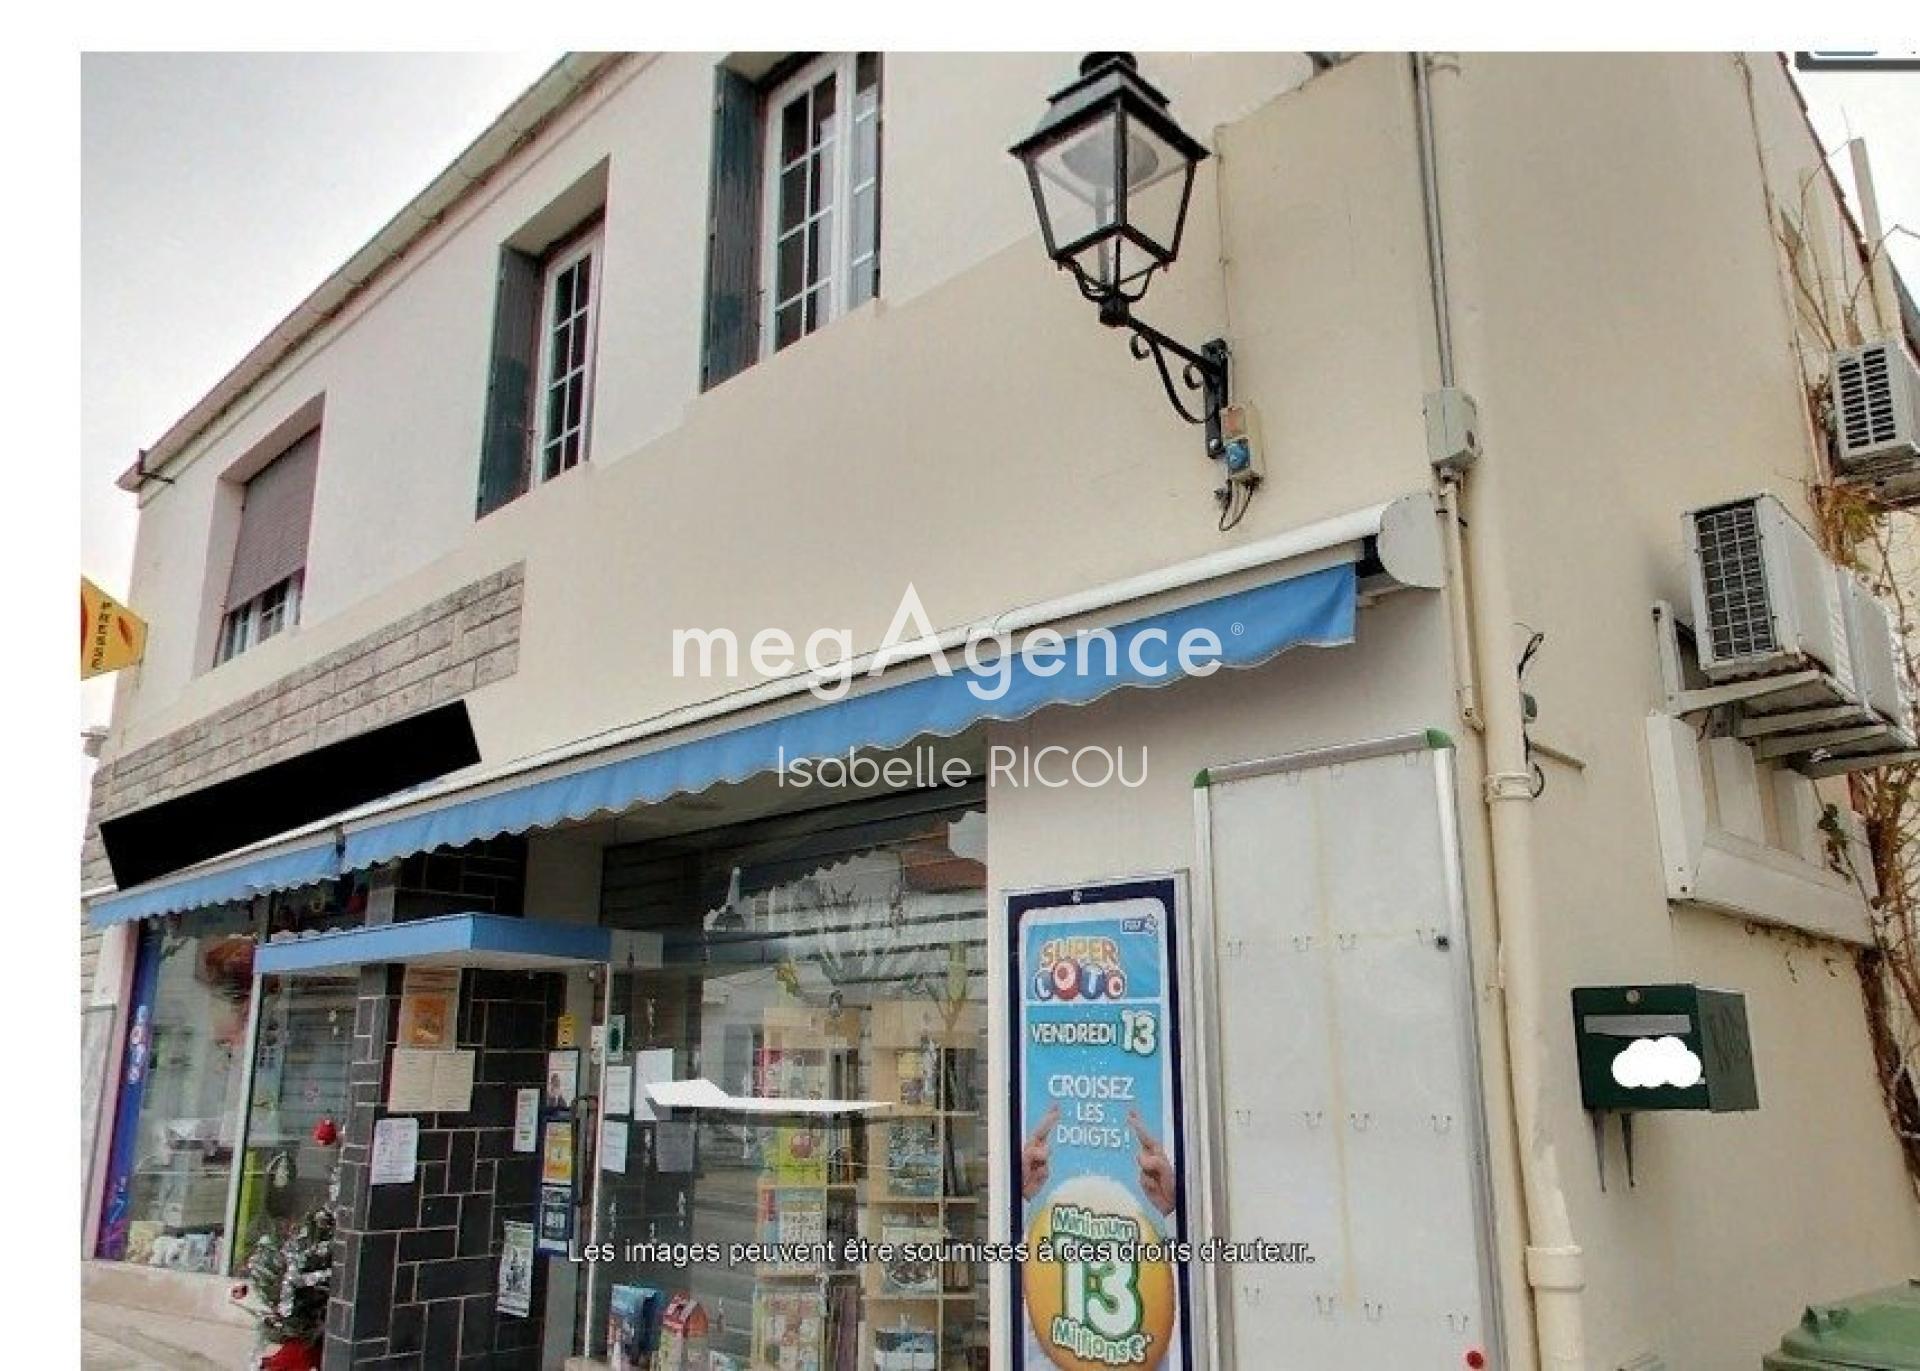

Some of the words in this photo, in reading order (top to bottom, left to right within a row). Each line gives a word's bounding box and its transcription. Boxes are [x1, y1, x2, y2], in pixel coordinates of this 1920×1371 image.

[1041, 937, 1121, 968] SUPER
[1034, 958, 1127, 1001] LOTO
[1032, 1022, 1117, 1046] VENDREDI
[1120, 1009, 1157, 1056] 13
[1048, 1074, 1136, 1100] CROISEZ
[1077, 1102, 1105, 1123] LES
[1052, 1204, 1140, 1240] Minimum
[1054, 1236, 1144, 1341] 13
